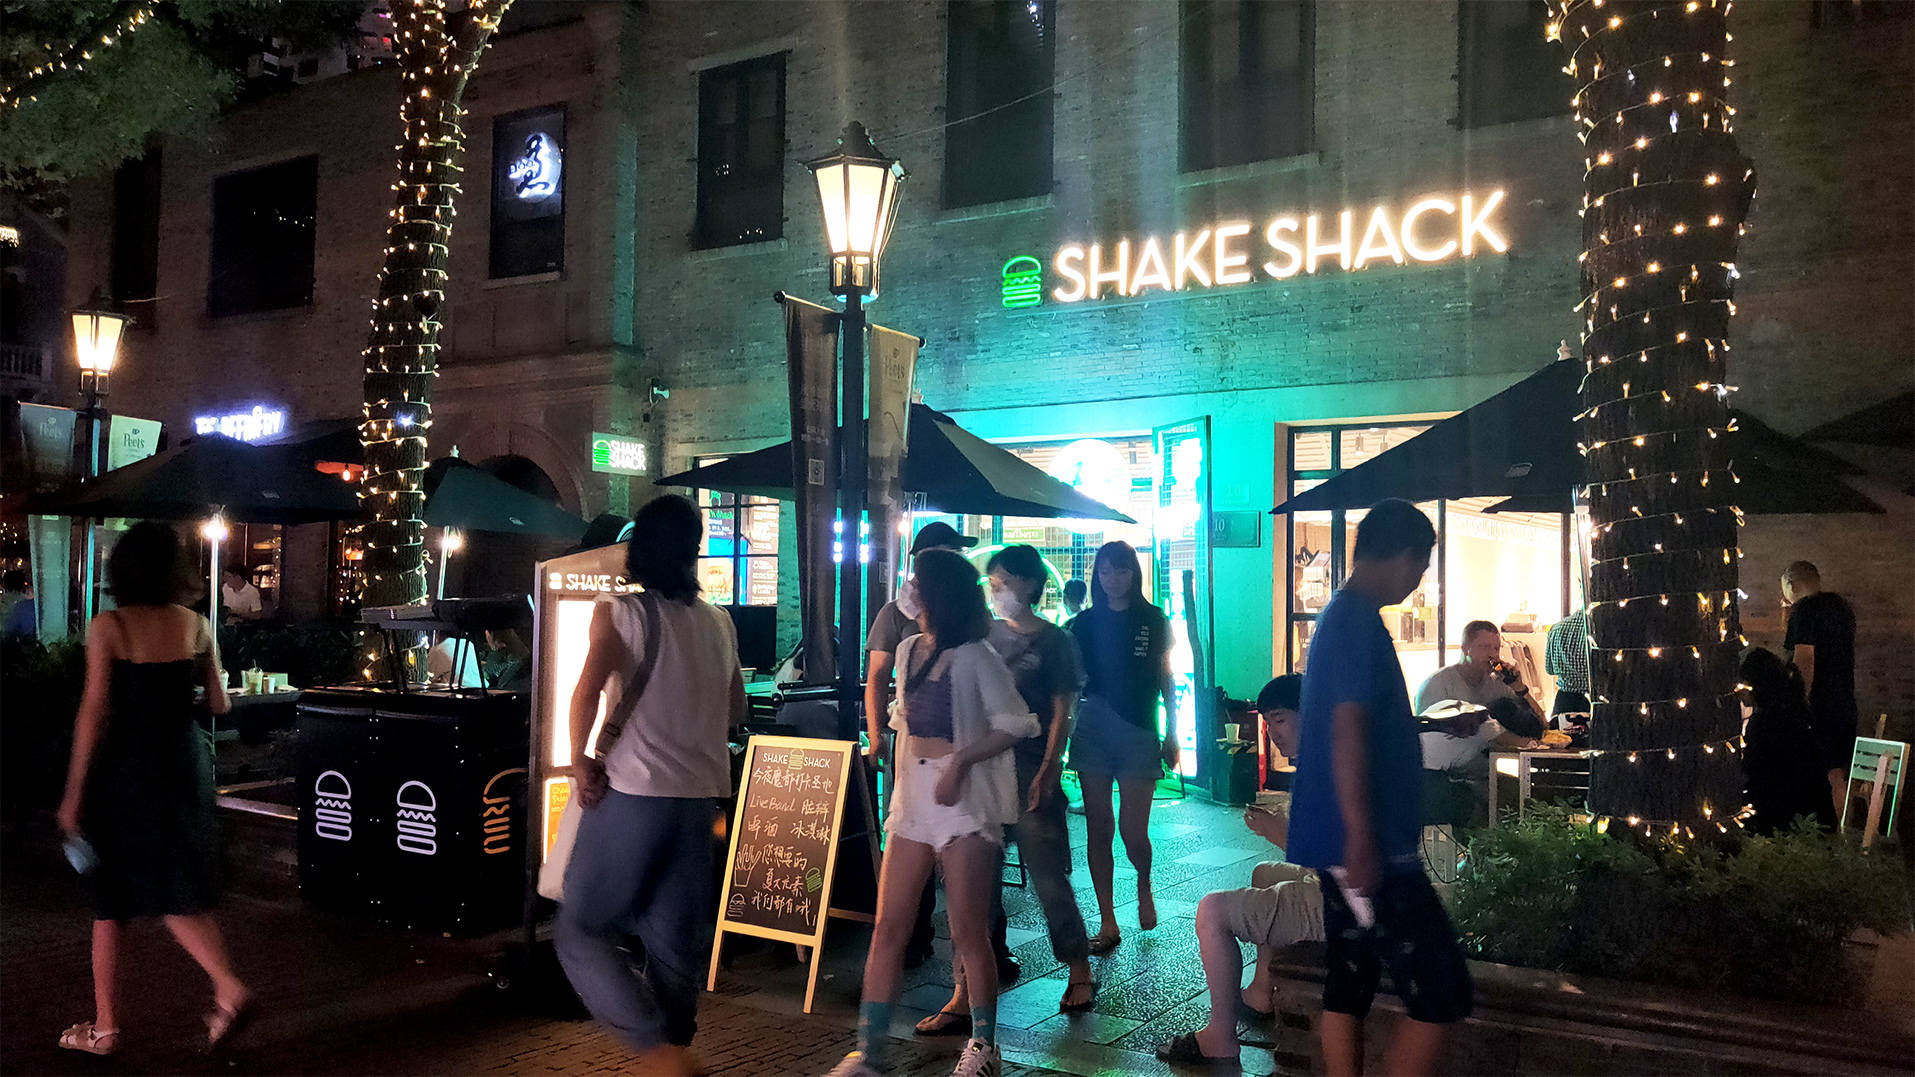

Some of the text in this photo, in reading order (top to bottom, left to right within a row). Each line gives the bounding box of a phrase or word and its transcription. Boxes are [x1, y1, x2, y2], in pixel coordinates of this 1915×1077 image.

[1053, 191, 1510, 302] SHAKE SHACK
[610, 440, 645, 456] SHAKE
[609, 453, 647, 471] SHACK
[565, 573, 611, 592] SHAKE
[763, 752, 831, 769] SHAKE SHACK
